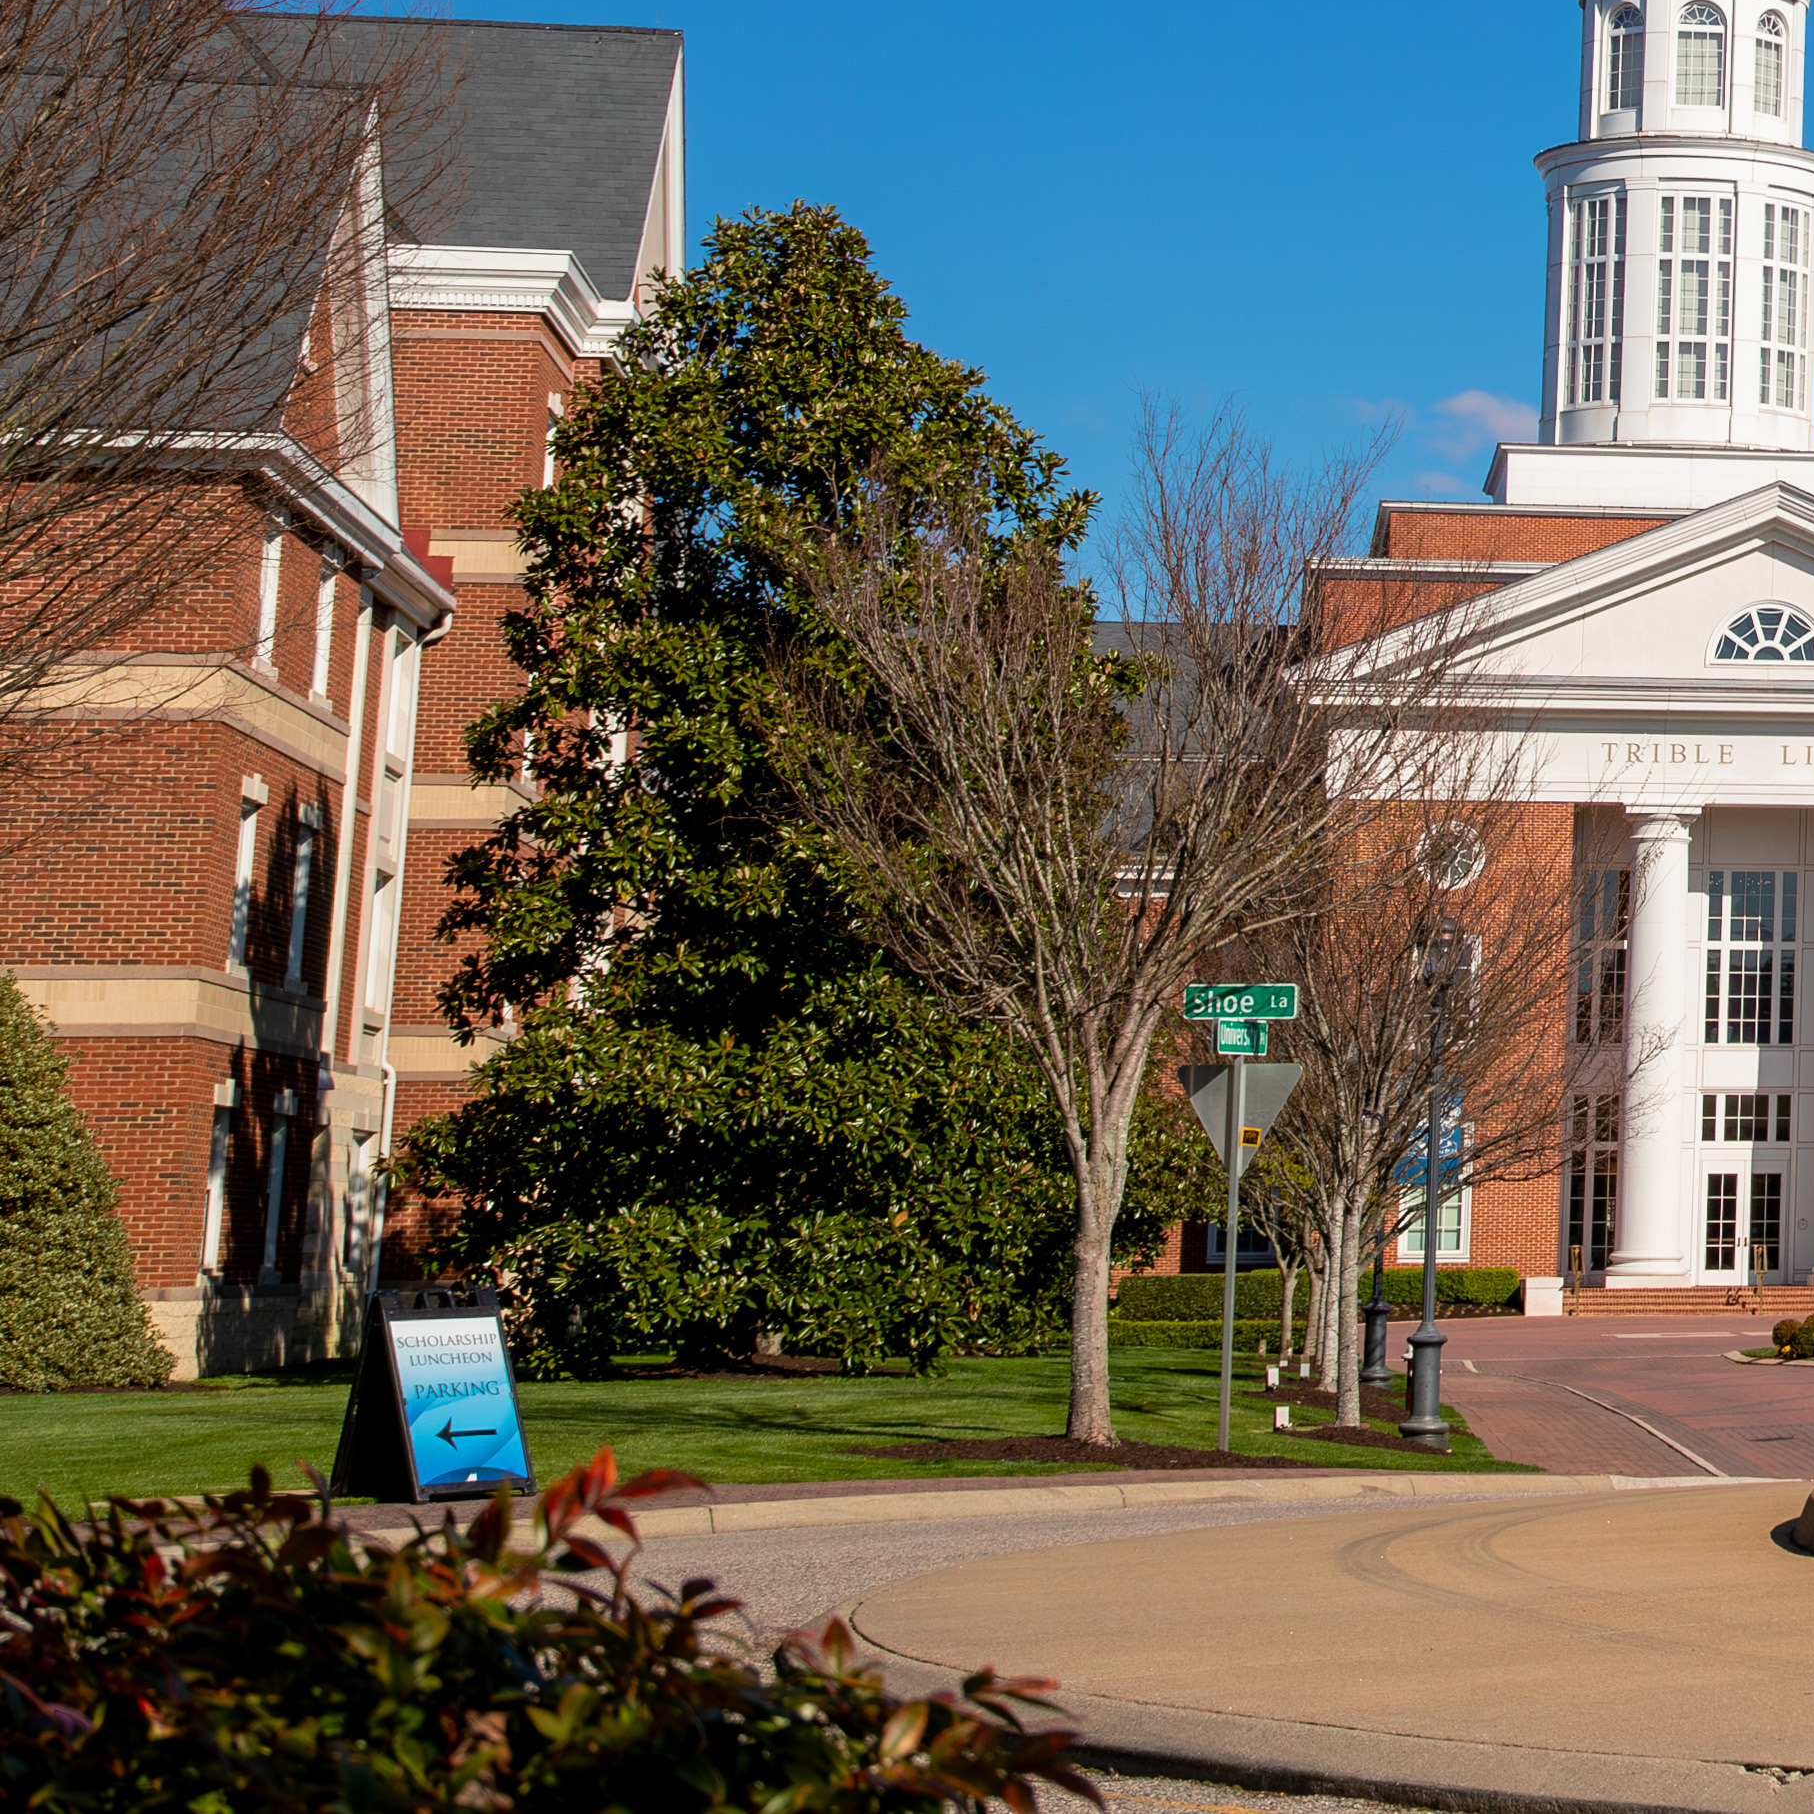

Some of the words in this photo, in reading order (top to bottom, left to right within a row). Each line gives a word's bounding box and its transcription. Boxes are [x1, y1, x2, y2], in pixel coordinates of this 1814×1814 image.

[1601, 742, 1734, 765] TRIBLE
[1193, 990, 1254, 1014] Shoe
[1271, 994, 1288, 1008] La
[396, 1333, 497, 1349] SCHOLARSHIP
[409, 1351, 493, 1367] LUNCHEON
[414, 1380, 500, 1399] PARKING
